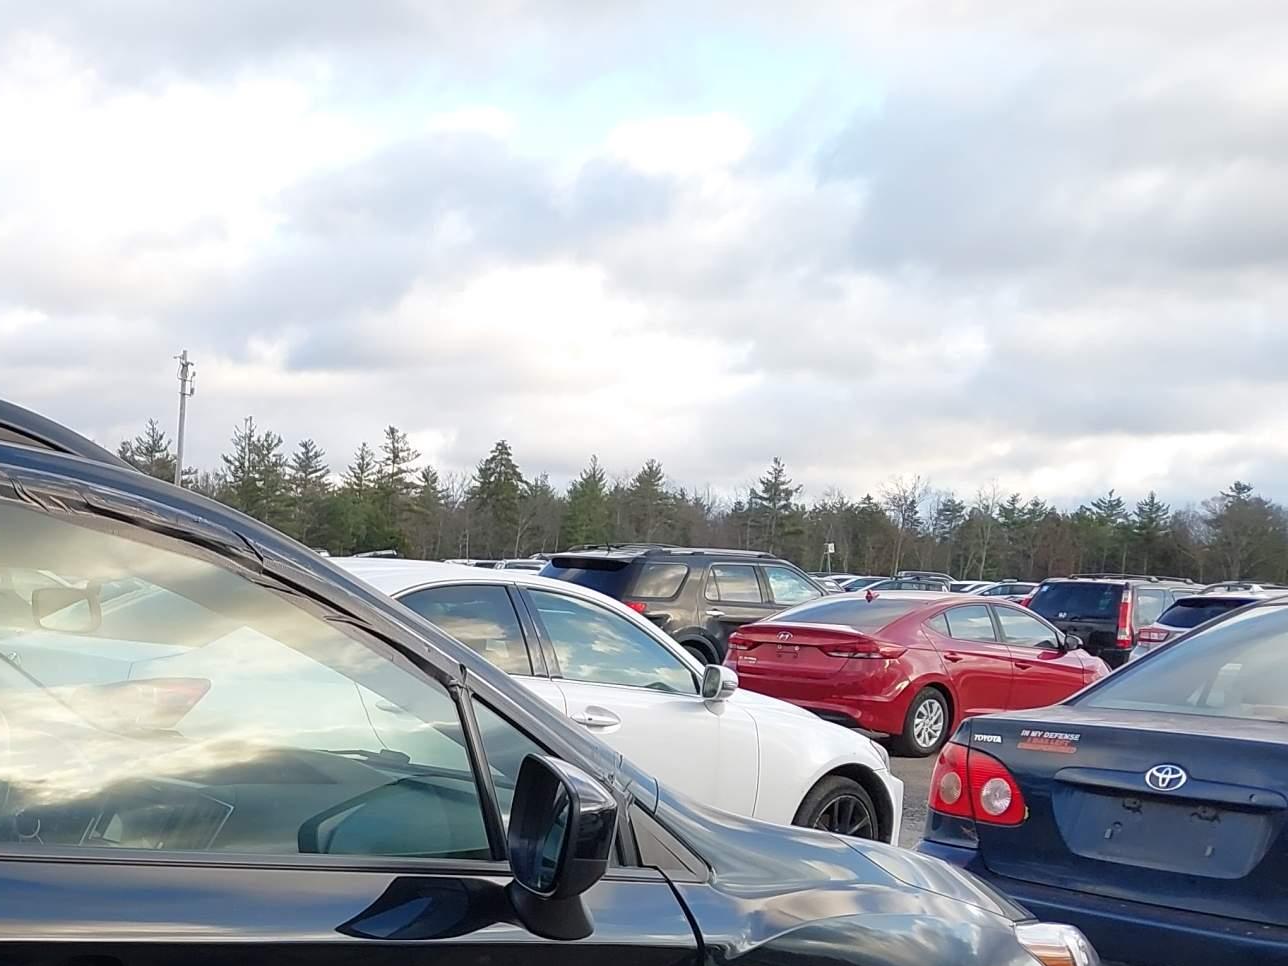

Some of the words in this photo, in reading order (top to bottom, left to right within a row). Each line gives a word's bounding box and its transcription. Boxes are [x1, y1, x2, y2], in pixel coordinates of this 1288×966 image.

[974, 734, 1002, 743] TOYOTA
[1020, 729, 1031, 737] IN
[1043, 731, 1081, 741] DEFENSE
